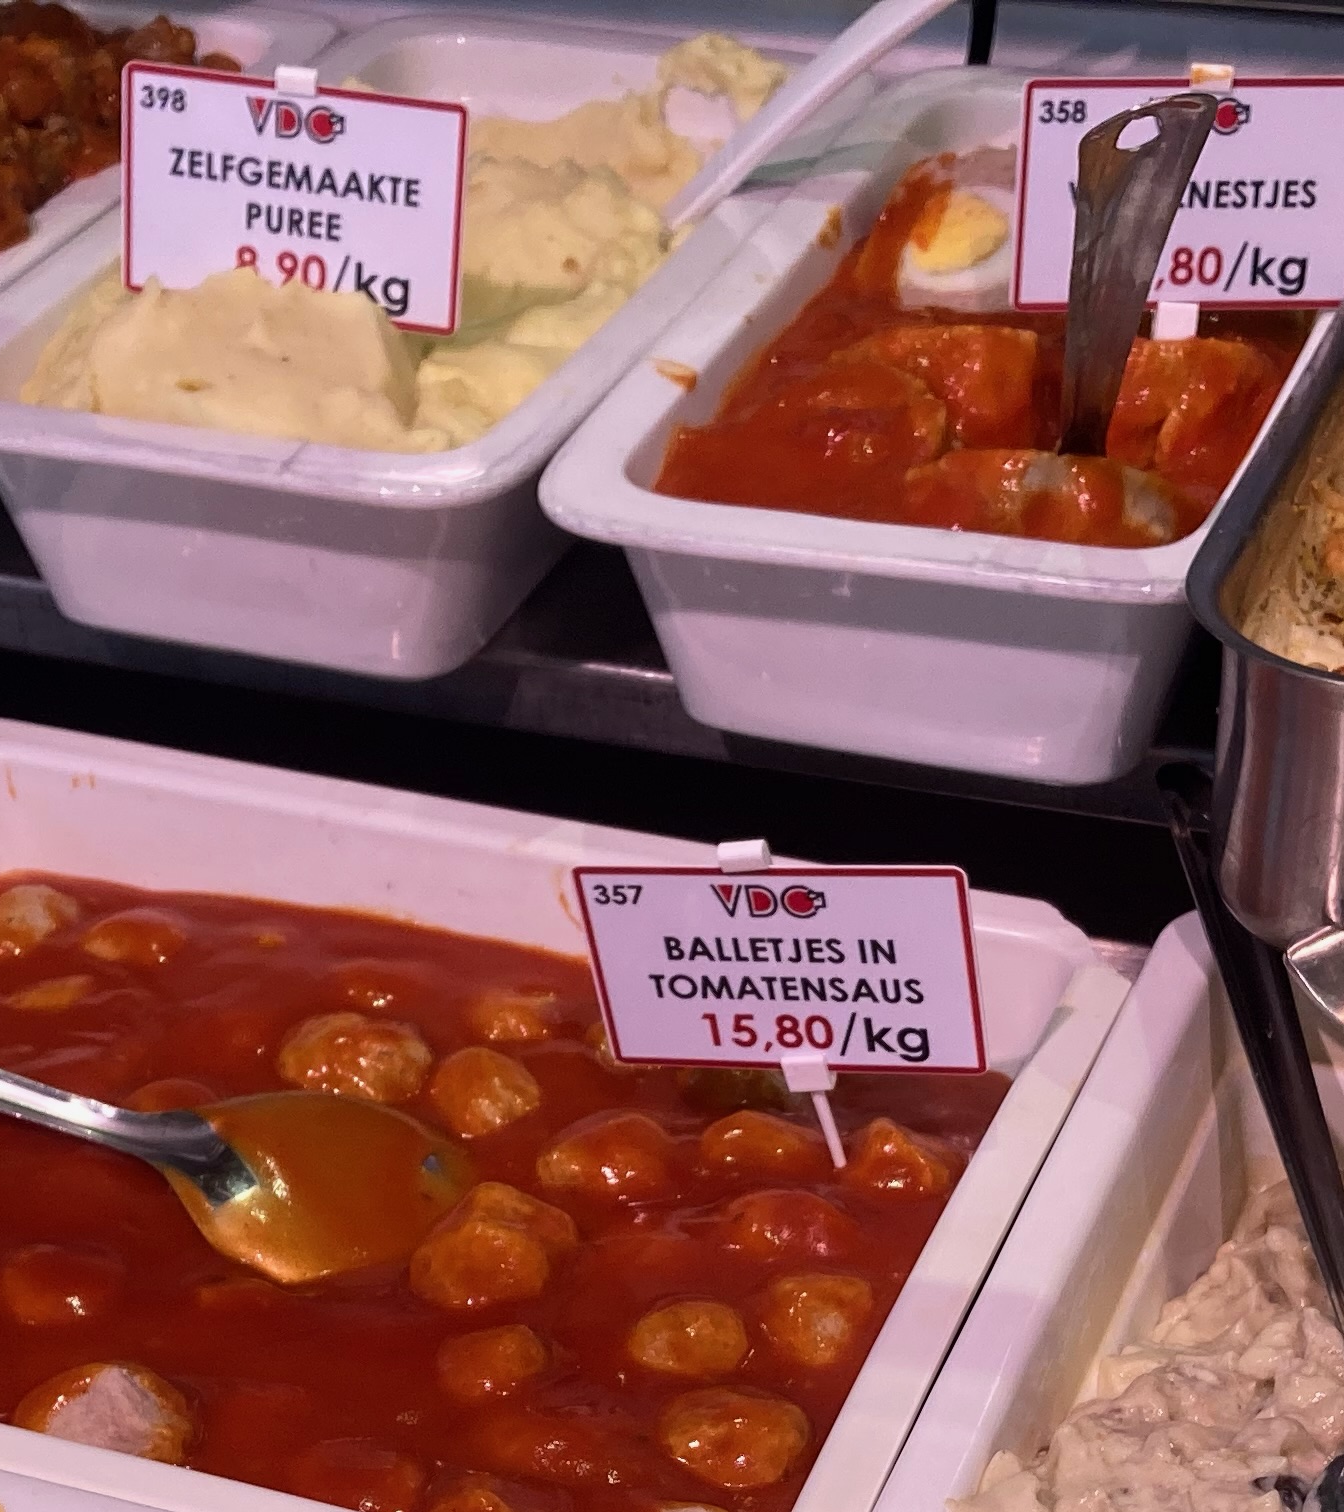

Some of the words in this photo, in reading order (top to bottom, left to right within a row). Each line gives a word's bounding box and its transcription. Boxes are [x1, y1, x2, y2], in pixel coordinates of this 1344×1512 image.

[140, 85, 187, 113] 398
[1039, 100, 1087, 124] 358
[169, 148, 420, 207] ZELFGEMAAKTE
[246, 202, 342, 241] PUREE
[236, 245, 410, 317] 890/kg
[593, 884, 643, 906] 357
[664, 935, 846, 964] BALLETJES
[859, 939, 897, 965] IN
[648, 973, 925, 1005] TOMATENSAUS
[702, 1011, 930, 1063] 15,80/kg
